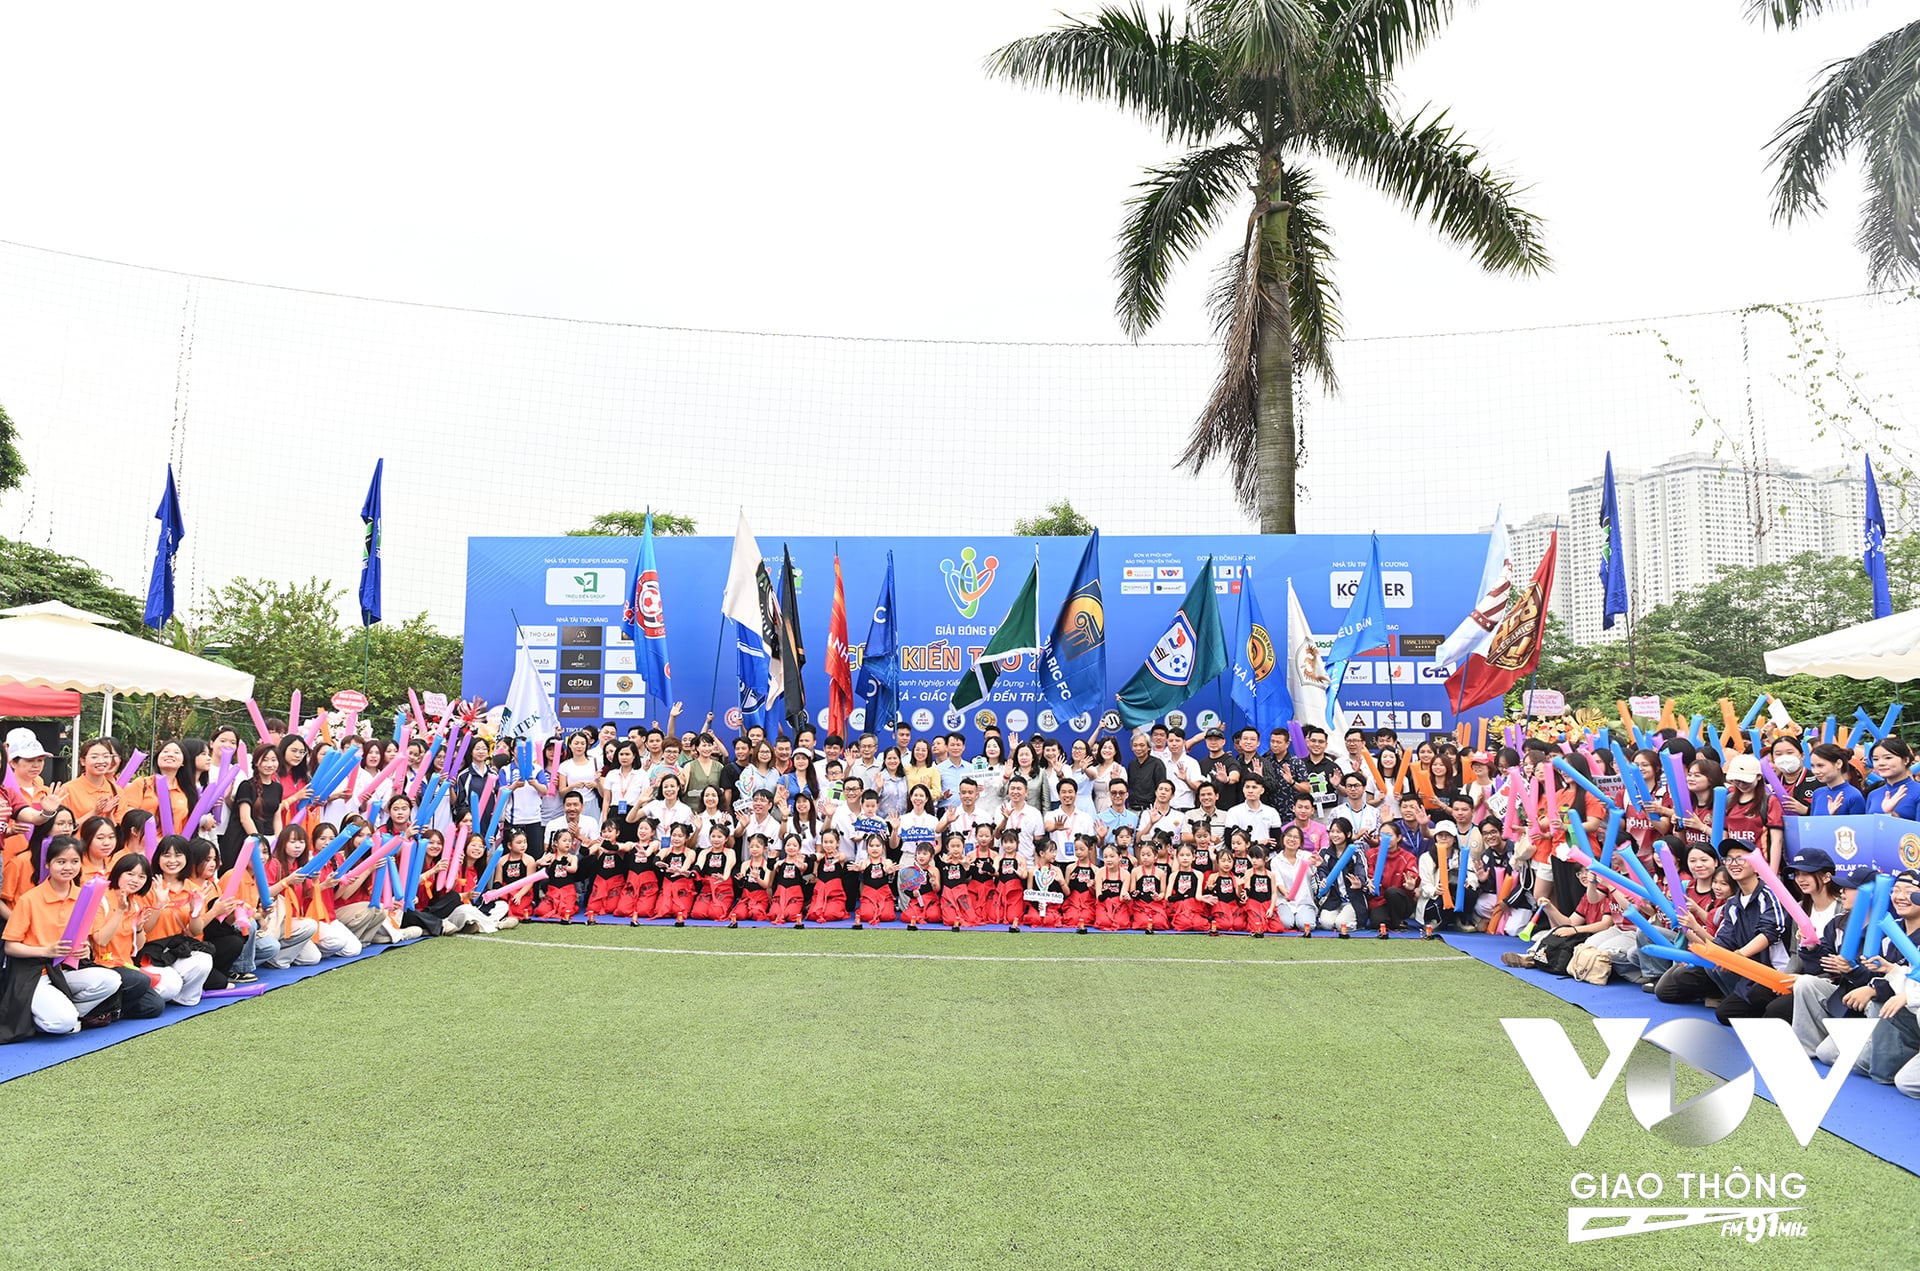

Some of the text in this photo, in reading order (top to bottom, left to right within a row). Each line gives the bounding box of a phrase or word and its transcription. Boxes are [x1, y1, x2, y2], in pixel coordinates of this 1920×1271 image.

[1160, 569, 1180, 577] VOV
[1337, 580, 1405, 597] KÖER
[935, 625, 956, 636] GIẢI
[958, 625, 987, 636] BÓNG
[901, 639, 961, 672] KIẾN
[567, 678, 593, 687] CEDELI
[918, 679, 945, 689] Nghiệp
[1003, 680, 1024, 689] Dựng
[919, 688, 948, 702] GIẤC
[992, 688, 1018, 702] ĐẾN
